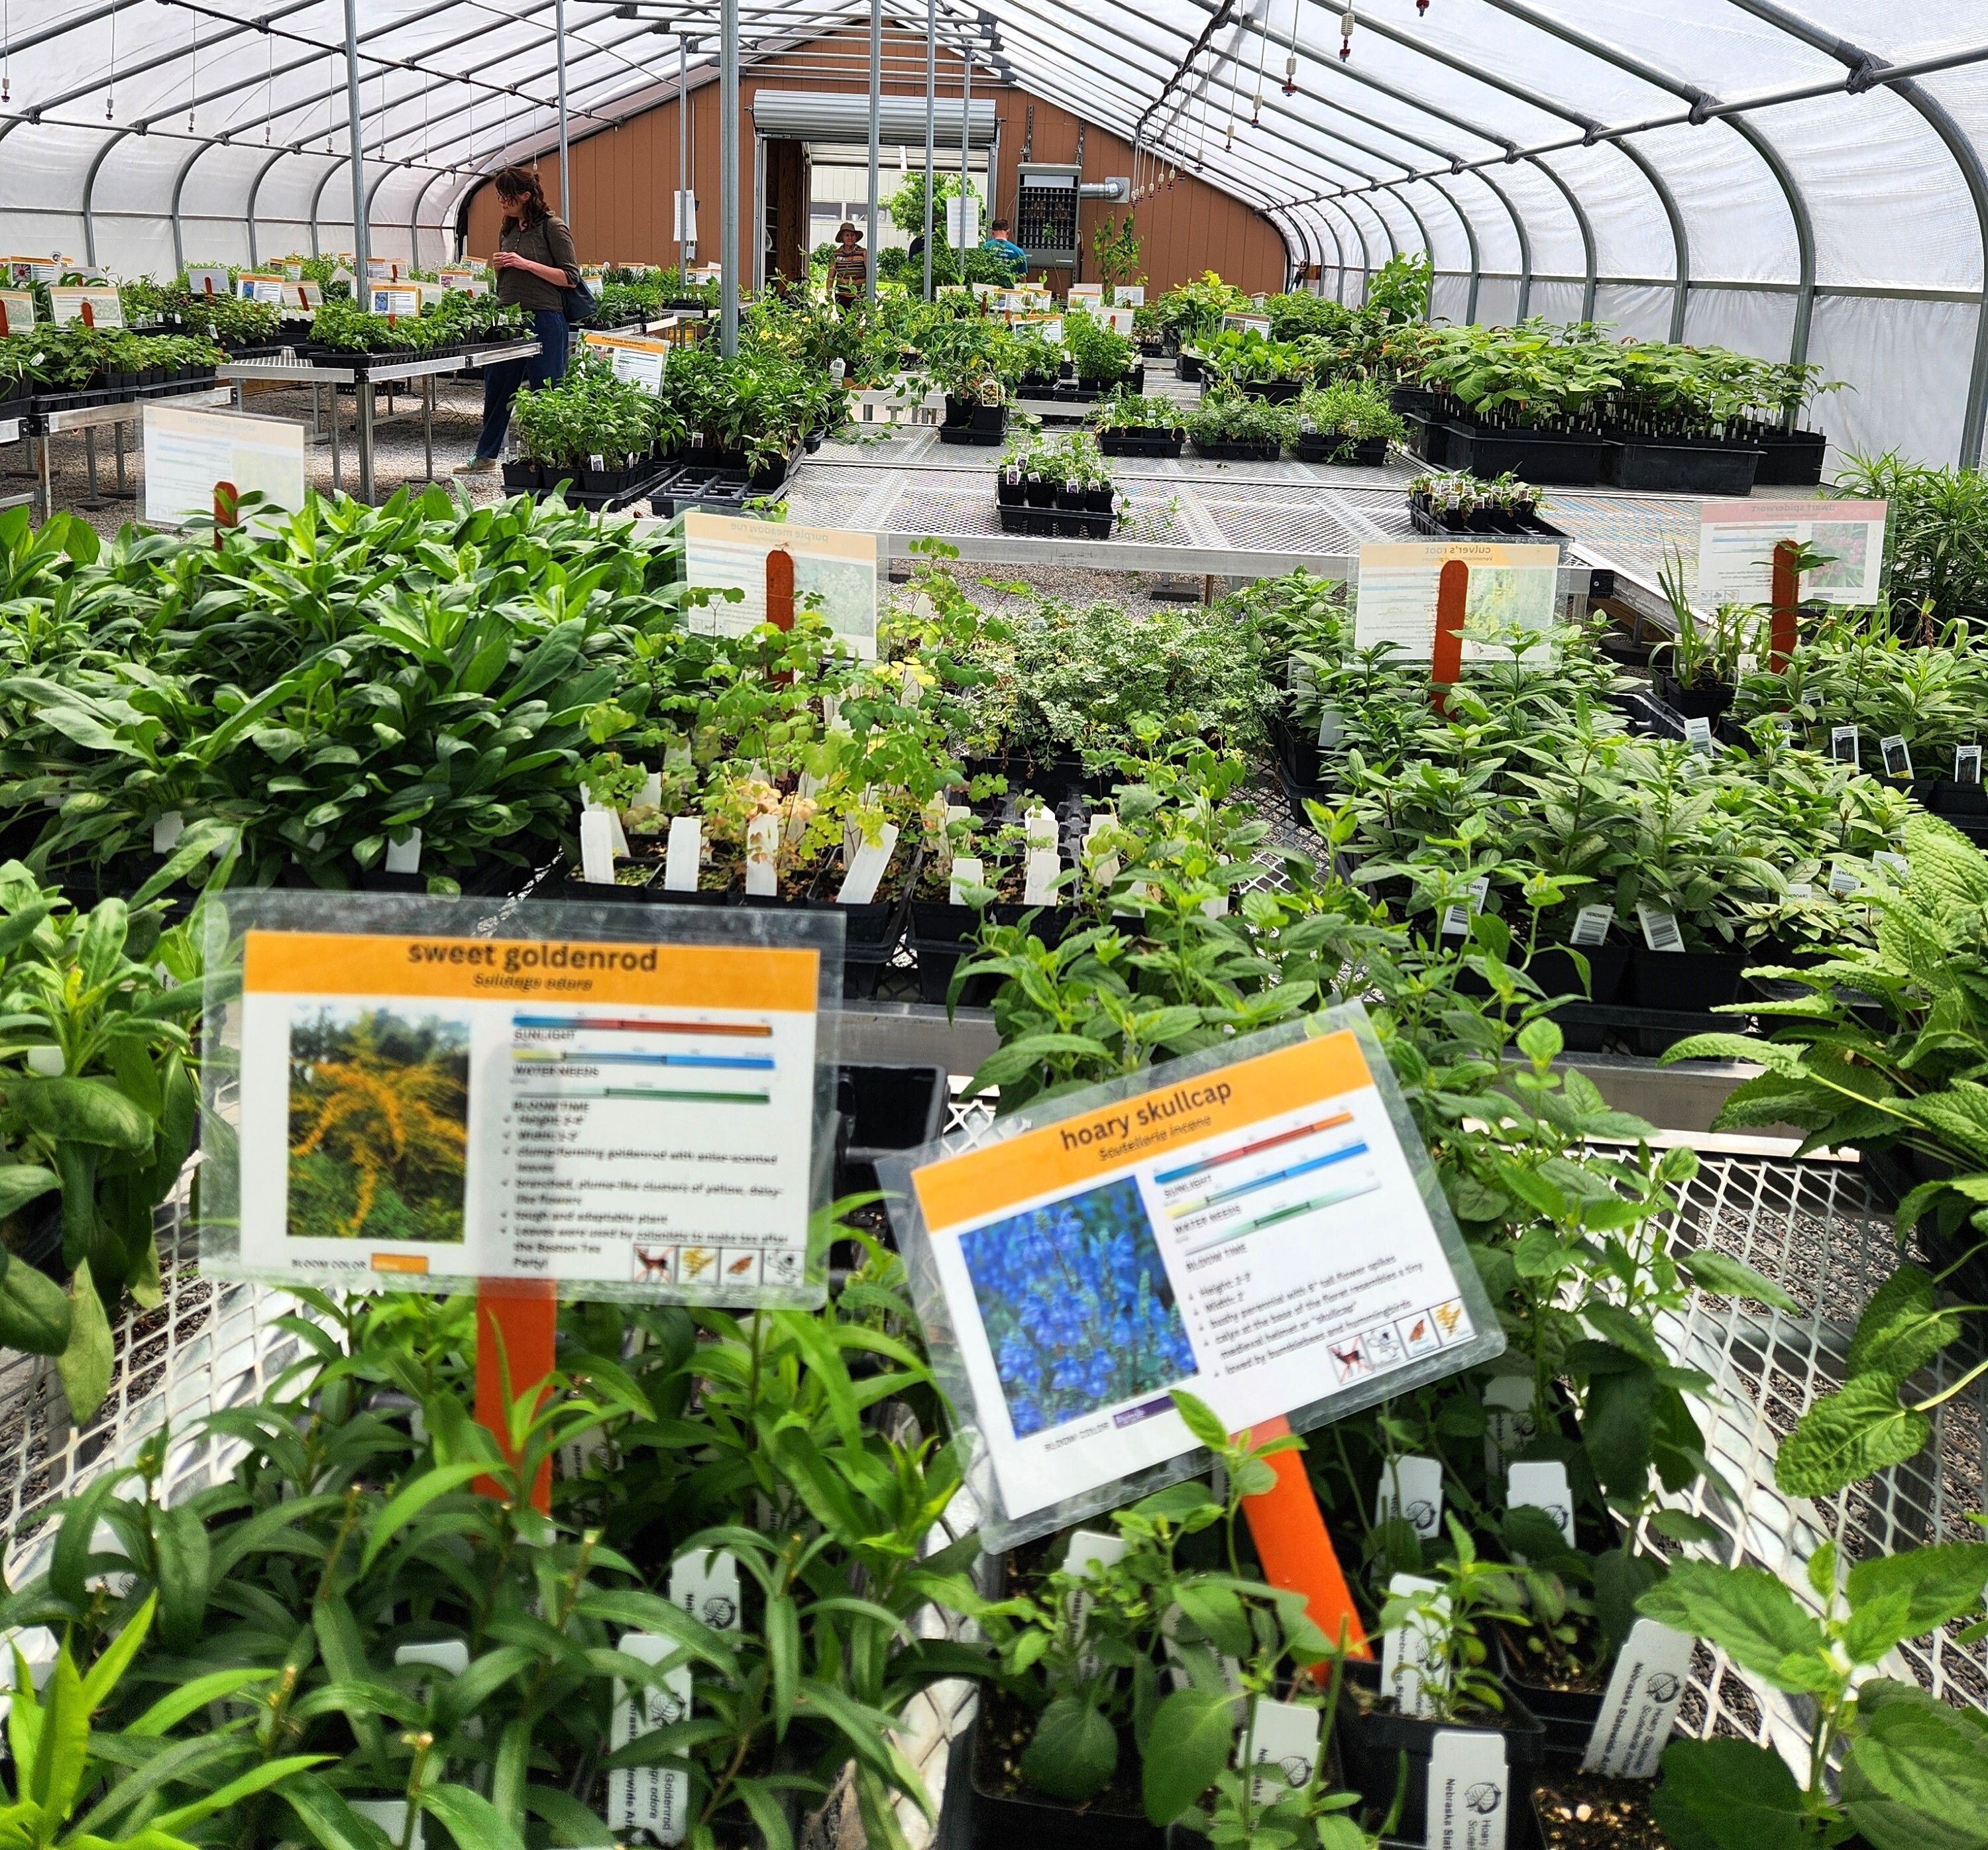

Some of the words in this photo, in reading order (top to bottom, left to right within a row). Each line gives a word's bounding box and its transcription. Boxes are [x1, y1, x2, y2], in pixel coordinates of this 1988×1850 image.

[408, 944, 497, 967] sweet
[504, 942, 658, 973] goldenrod
[472, 972, 542, 993] Solidago
[1061, 1113, 1130, 1152] hoary
[1136, 1082, 1231, 1126] skullcap
[1622, 1662, 1645, 1706] Nebraska
[649, 1789, 660, 1820] odora
[663, 1772, 675, 1831] Goldenrod
[1443, 1778, 1456, 1826] Nebraska
